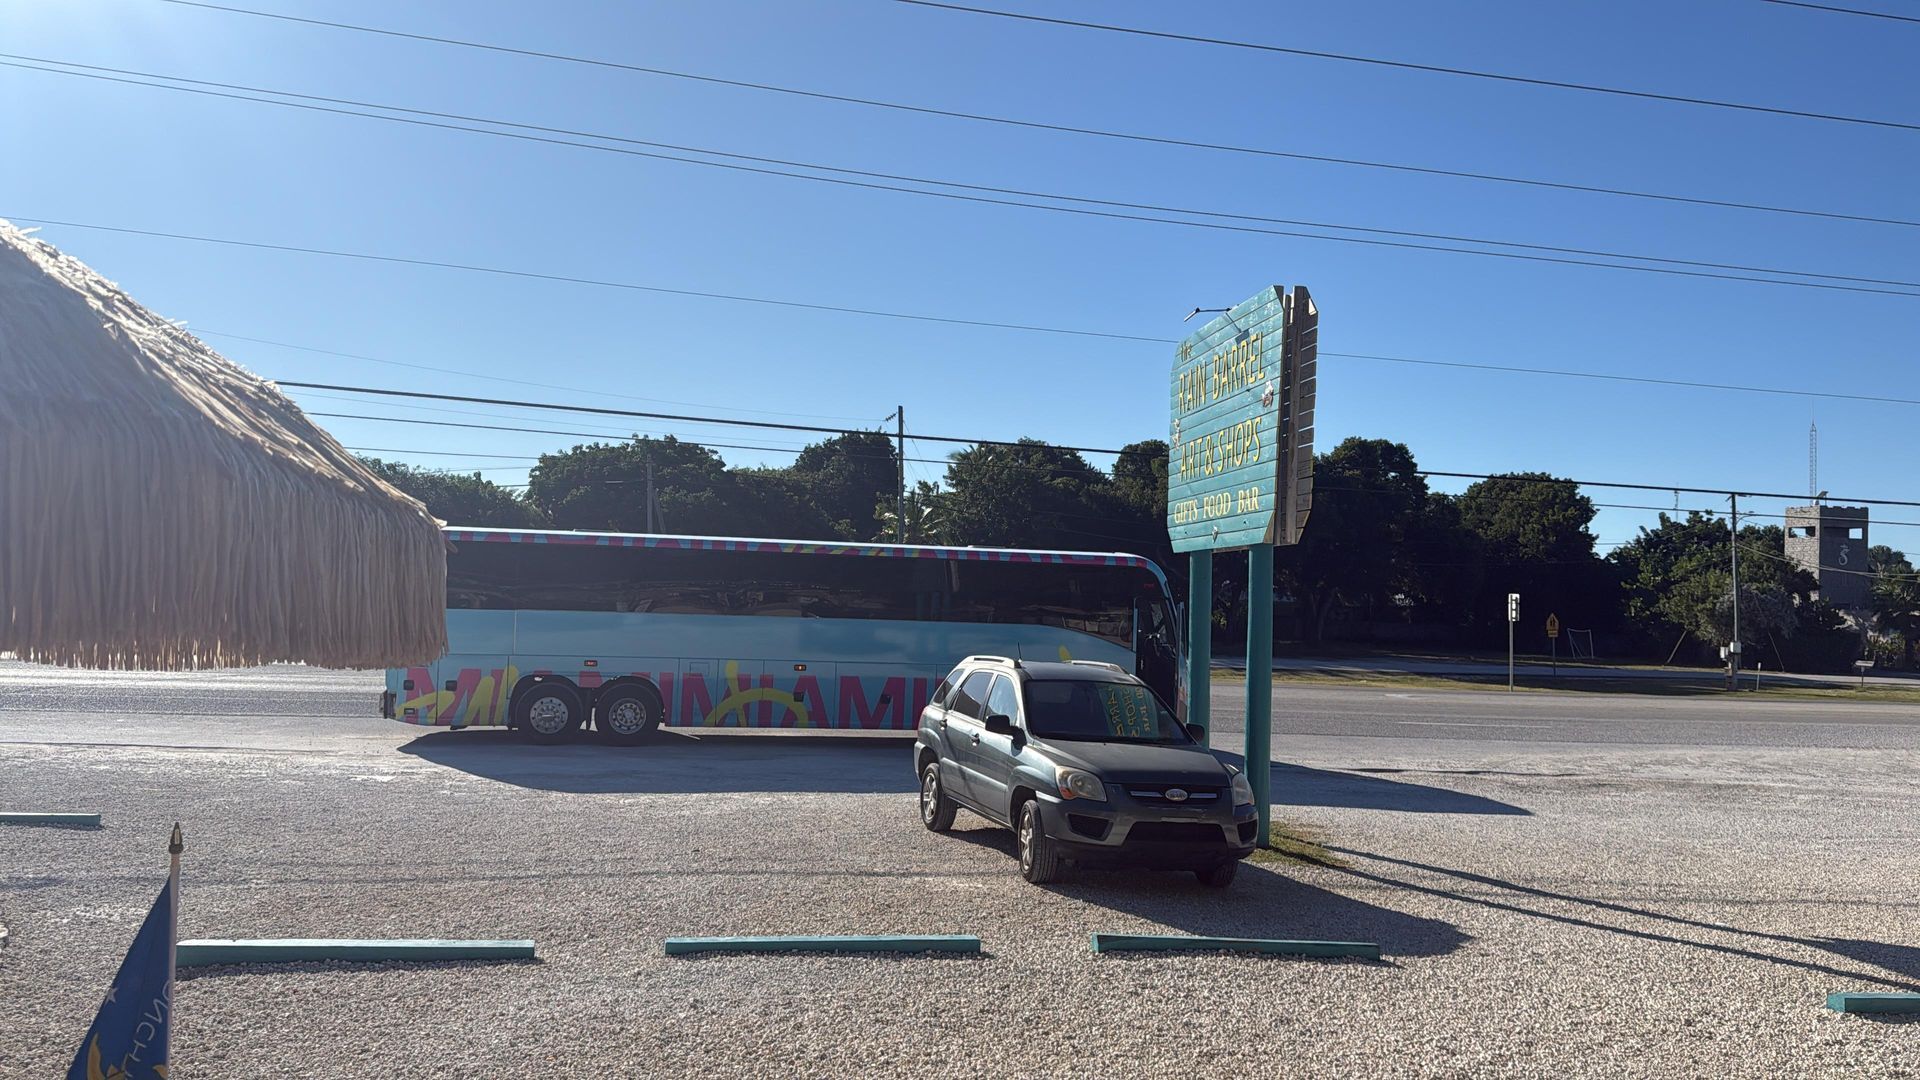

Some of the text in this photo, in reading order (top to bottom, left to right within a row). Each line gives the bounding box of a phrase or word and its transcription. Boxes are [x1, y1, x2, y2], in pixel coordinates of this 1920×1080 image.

[1178, 332, 1266, 415] RAIN BARREL
[1180, 416, 1263, 483] ART & SHOPS
[1174, 486, 1260, 524] GIFTS FOOD BAR
